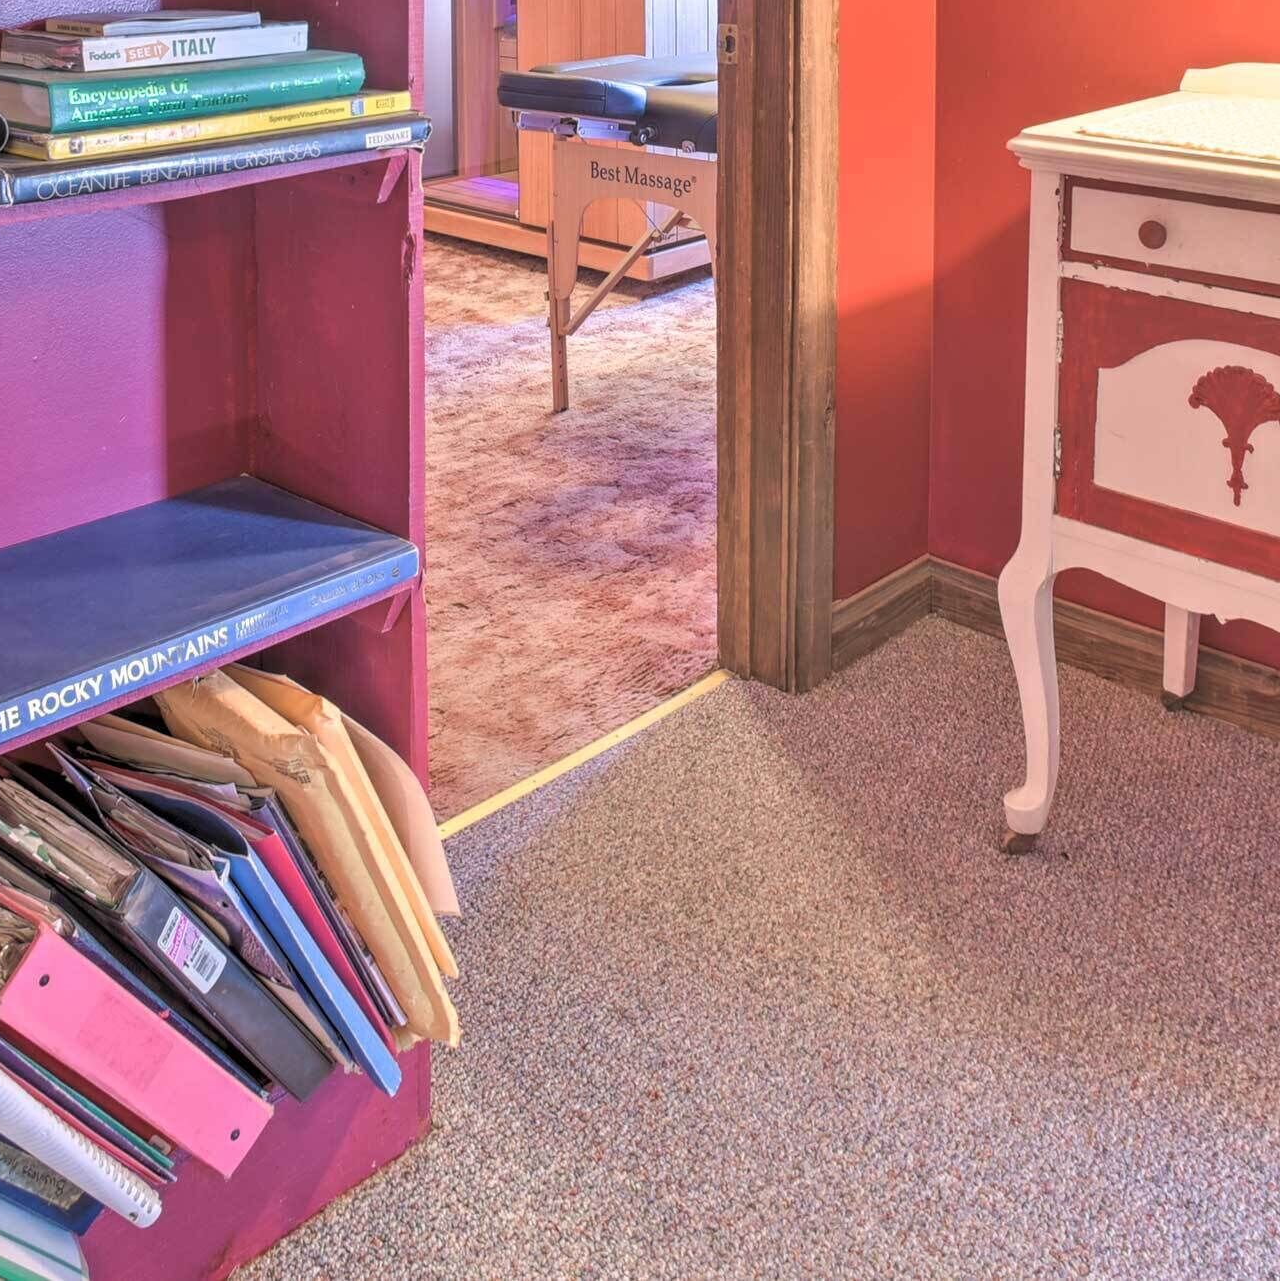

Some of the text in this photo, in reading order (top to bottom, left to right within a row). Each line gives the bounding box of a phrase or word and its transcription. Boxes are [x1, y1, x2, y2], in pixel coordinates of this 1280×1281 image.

[89, 36, 217, 62] Fodor's SEE IT ITALY
[368, 129, 410, 146] TED SMART
[37, 175, 109, 202] OCEAN
[107, 173, 131, 191] LIFE
[235, 147, 290, 170] CRYSTAL
[288, 140, 321, 162] SEAS
[590, 161, 622, 183] Best
[26, 673, 105, 718] ROCKY
[109, 626, 229, 688] MOUNTAINS
